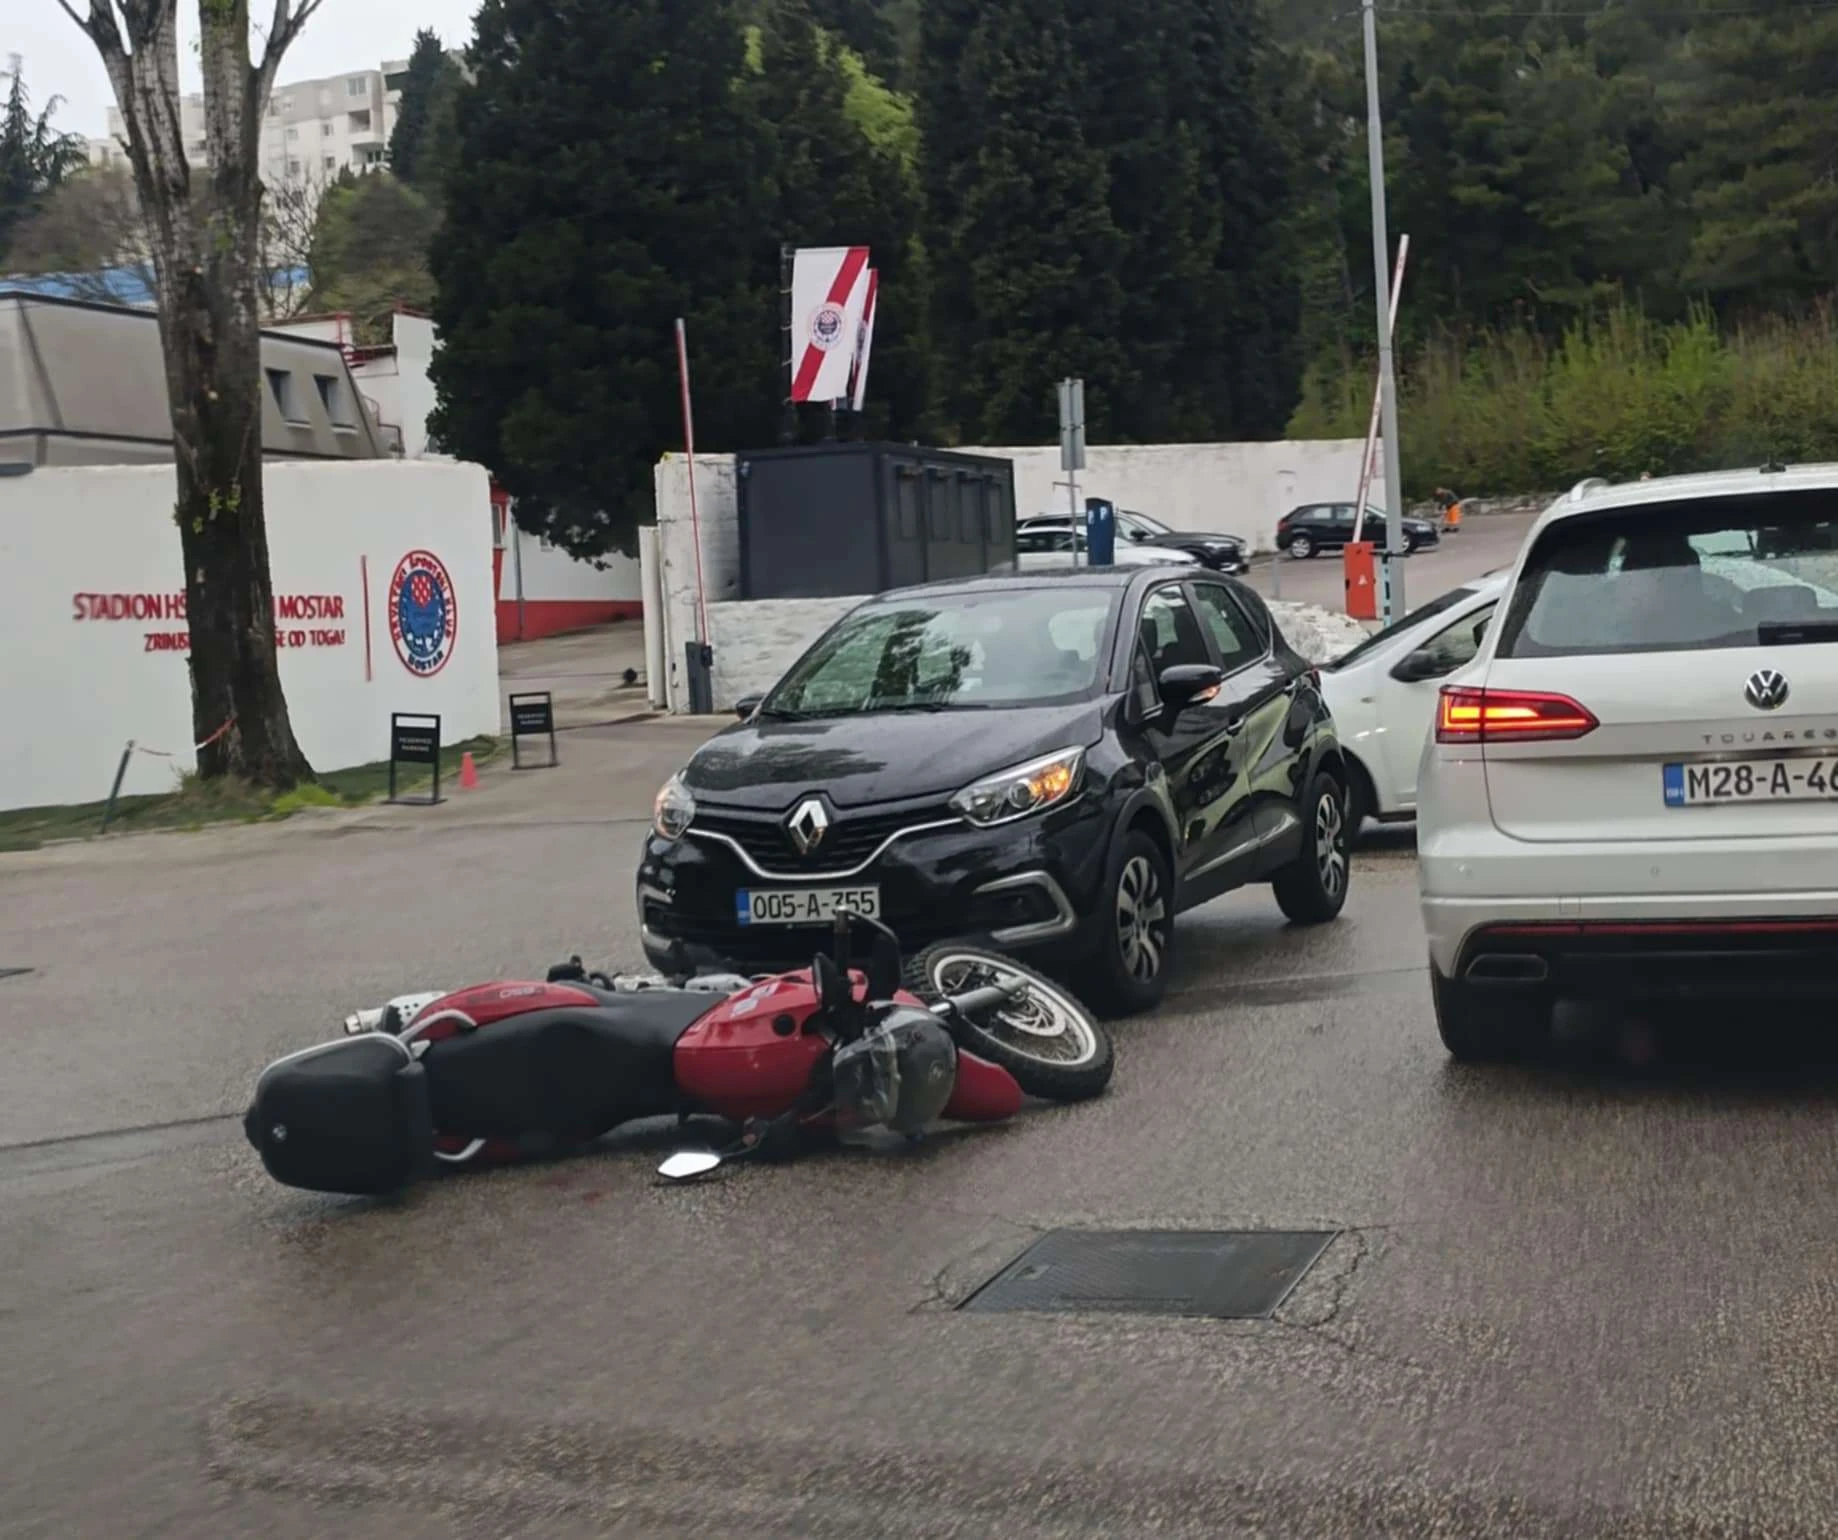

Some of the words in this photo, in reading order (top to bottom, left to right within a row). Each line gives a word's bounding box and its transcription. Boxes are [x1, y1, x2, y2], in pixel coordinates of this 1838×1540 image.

[72, 592, 161, 620] STADION
[165, 588, 187, 619] HŠ
[279, 595, 344, 619] MOSTAR
[288, 630, 306, 648] OD
[753, 891, 875, 920] 005-A-355
